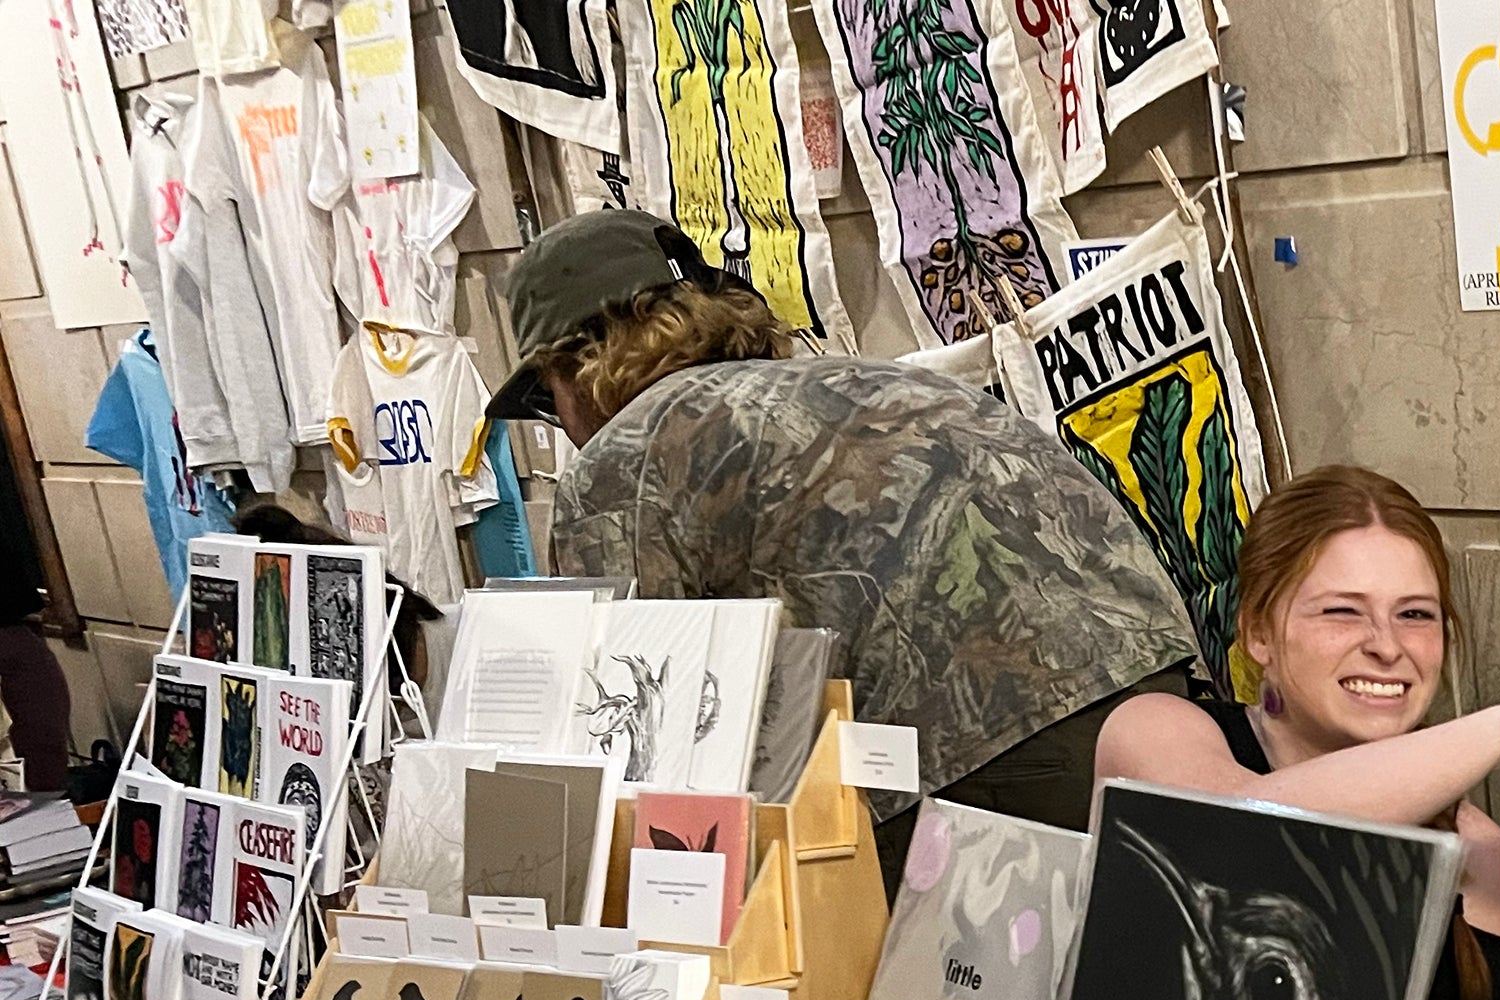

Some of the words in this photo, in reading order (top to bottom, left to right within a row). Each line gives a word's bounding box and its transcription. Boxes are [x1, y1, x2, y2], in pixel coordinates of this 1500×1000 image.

[1034, 260, 1205, 411] PATRIOT
[279, 690, 300, 717] SEE
[278, 718, 322, 756] WORLD
[945, 958, 982, 990] little
